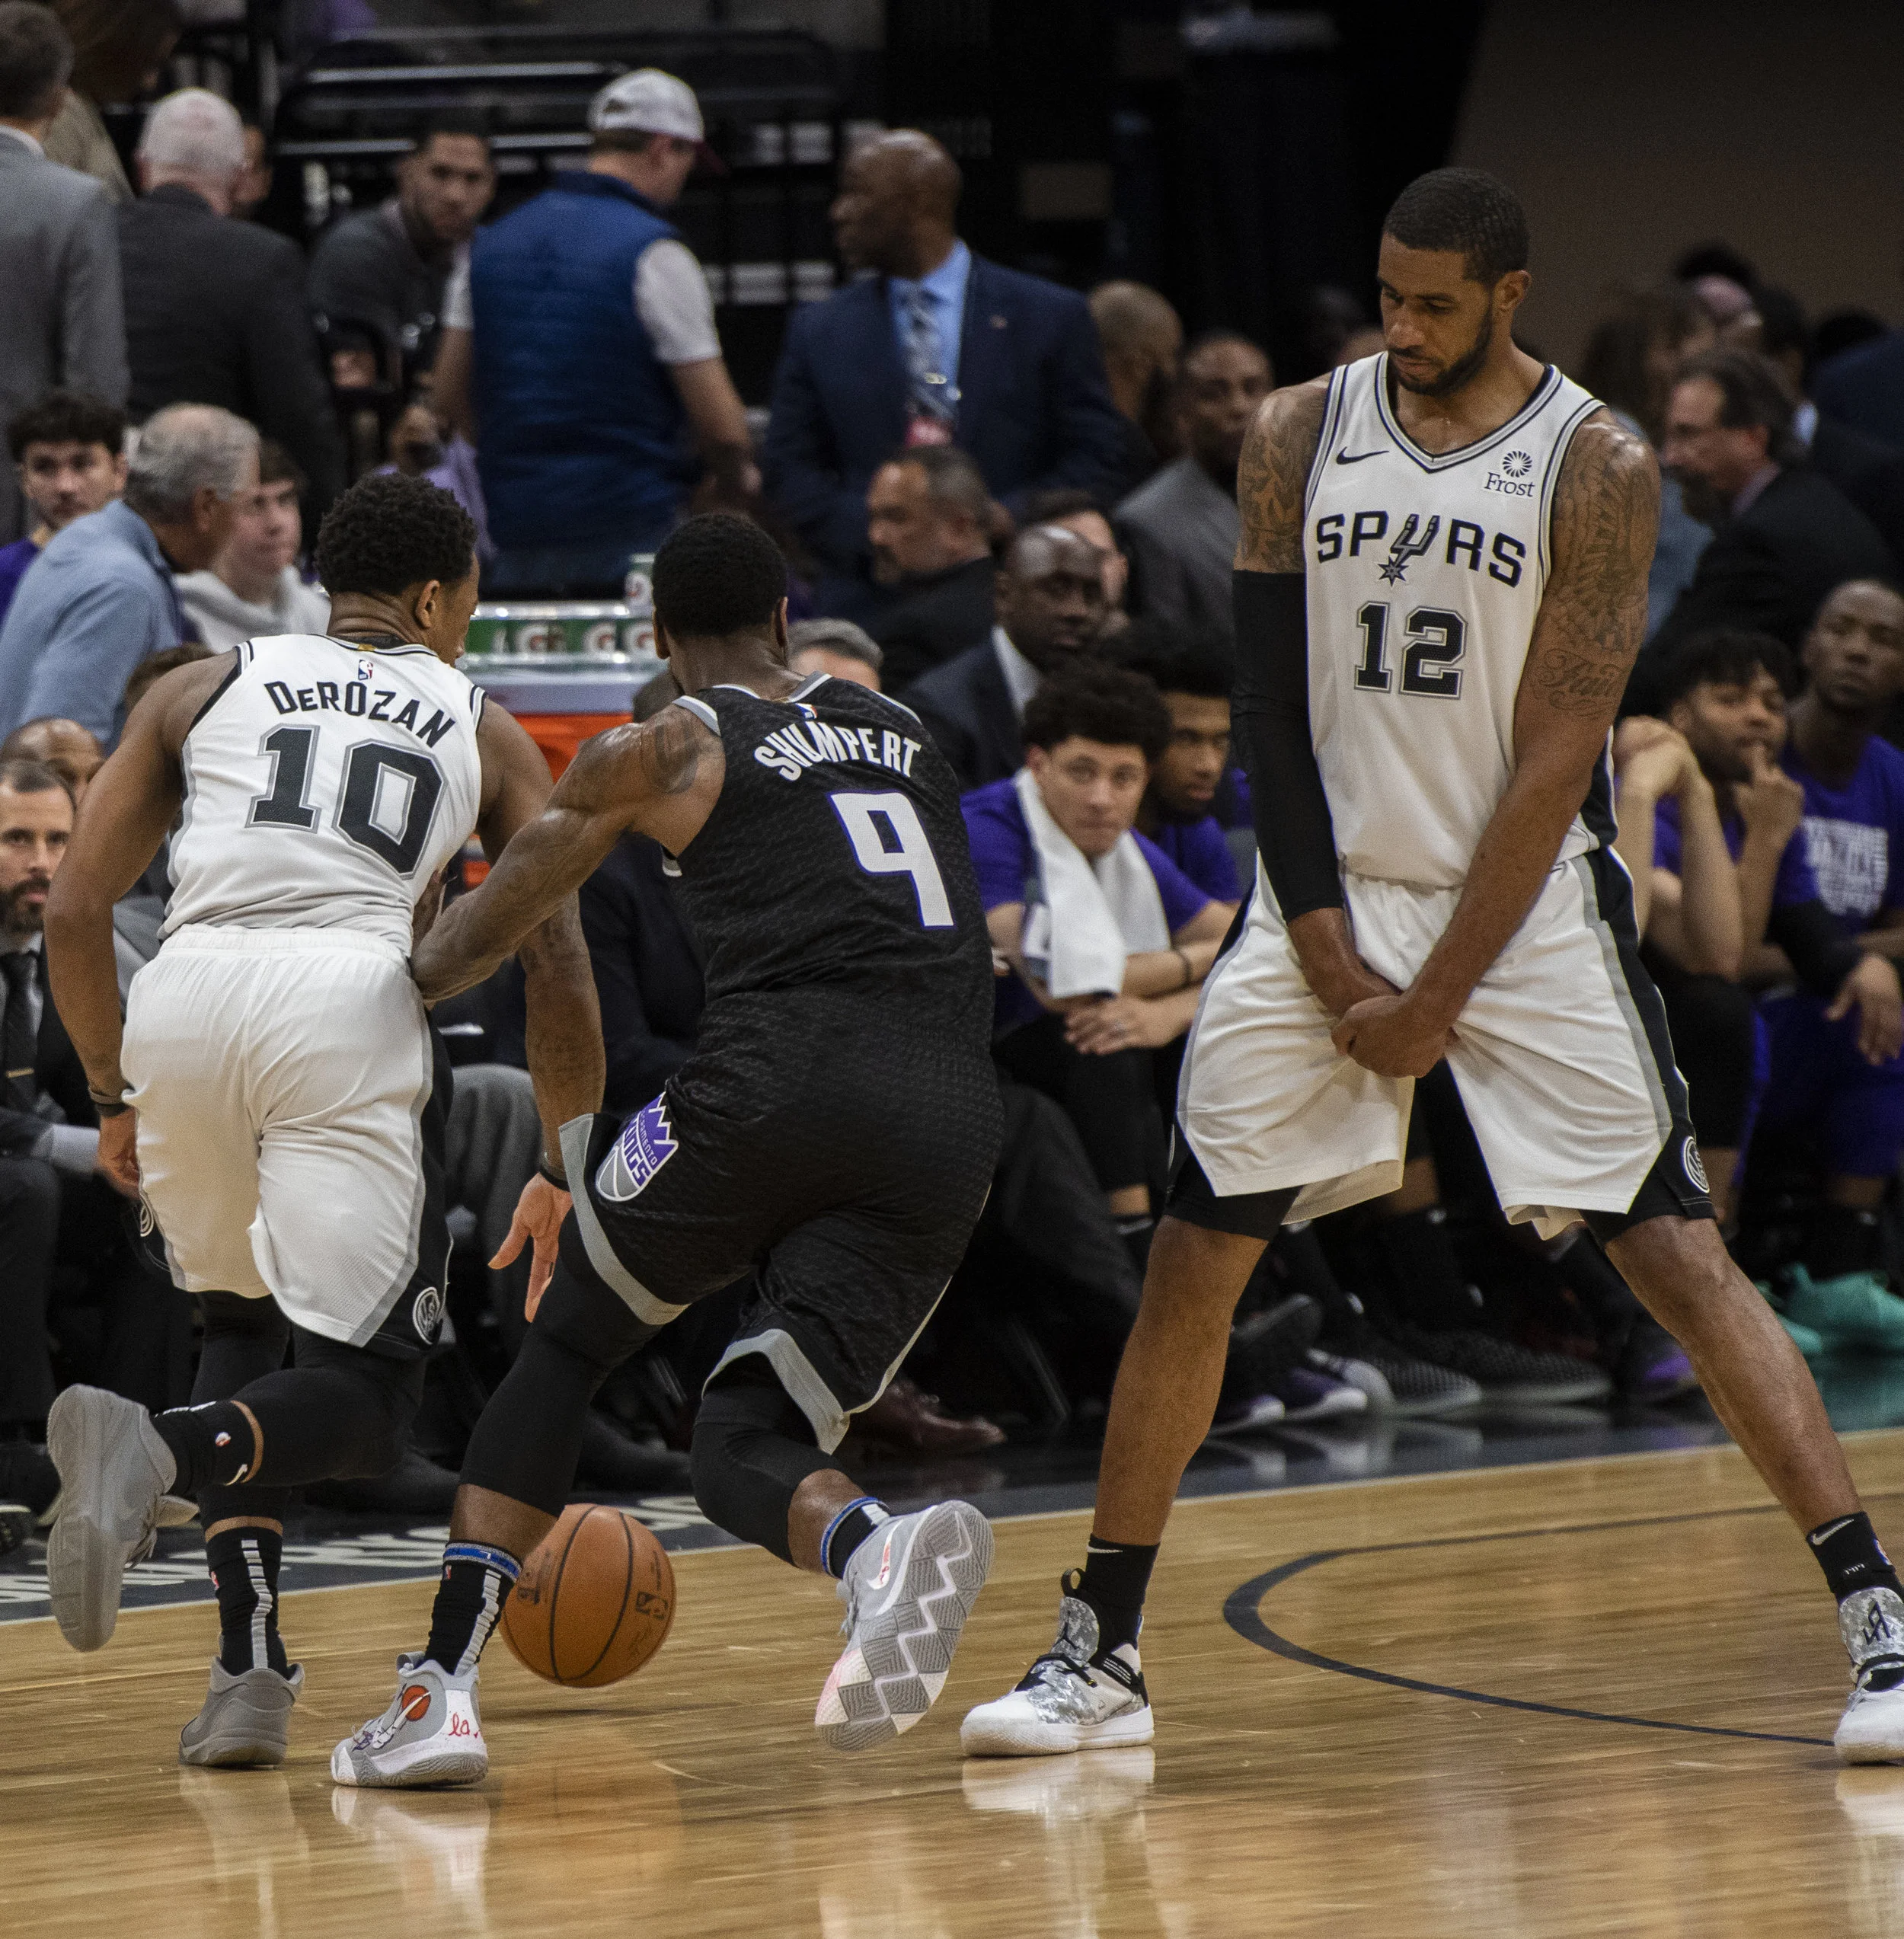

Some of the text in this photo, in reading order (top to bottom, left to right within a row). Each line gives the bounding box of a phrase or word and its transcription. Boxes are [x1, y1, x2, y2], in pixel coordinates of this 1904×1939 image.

[1484, 472, 1535, 497] Frost
[1316, 510, 1526, 589] SPURS
[1354, 601, 1468, 700] 12
[753, 720, 922, 781] SHUMPERT
[244, 722, 449, 881] 10
[826, 789, 956, 929] 9
